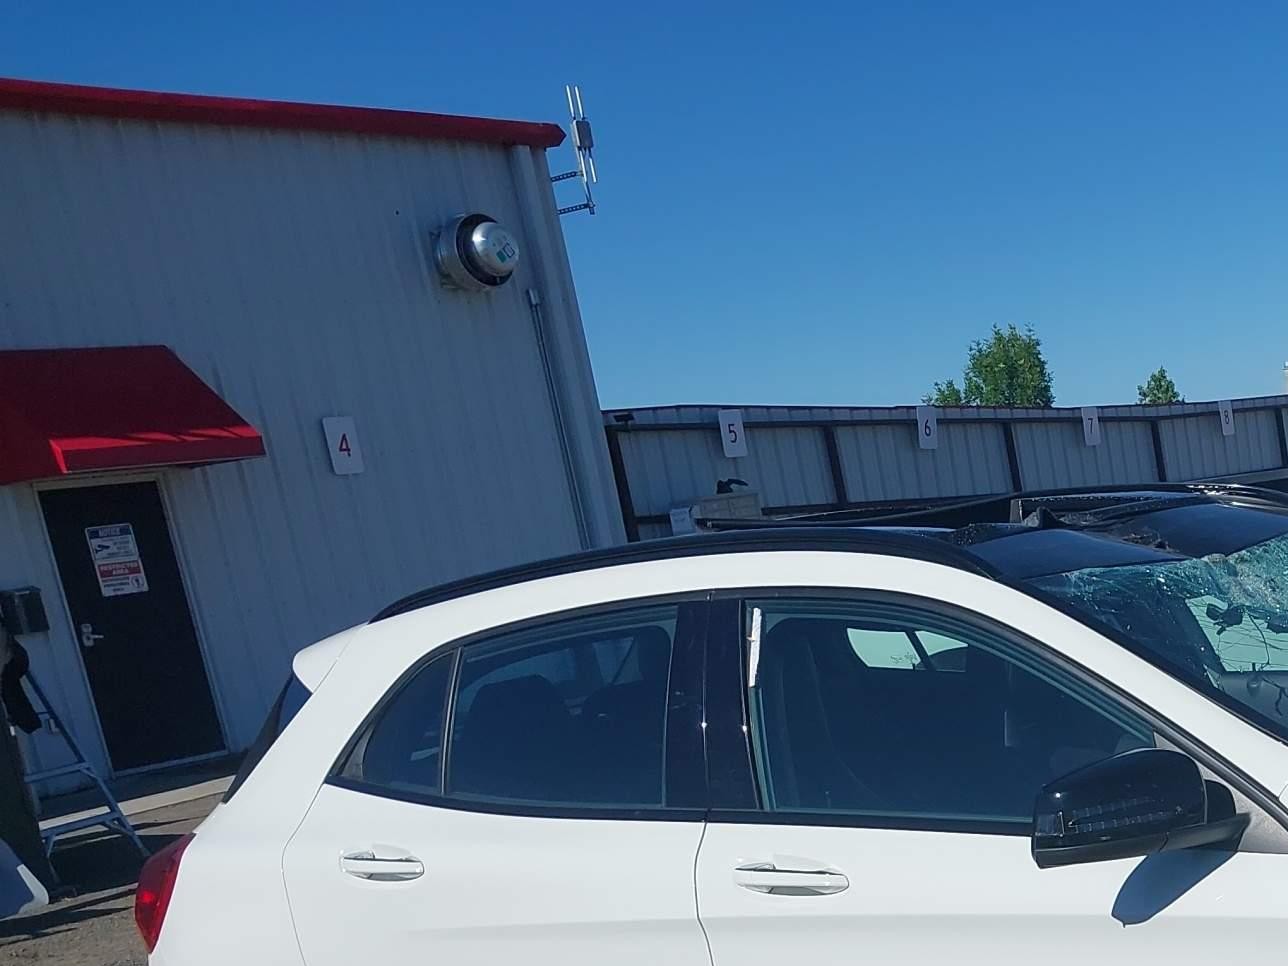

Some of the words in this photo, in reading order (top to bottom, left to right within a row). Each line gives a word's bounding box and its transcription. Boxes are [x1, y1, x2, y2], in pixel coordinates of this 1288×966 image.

[1087, 418, 1094, 434] 7
[1223, 410, 1230, 425] 8
[727, 423, 738, 443] 5
[924, 419, 932, 437] 6
[339, 433, 351, 457] 4
